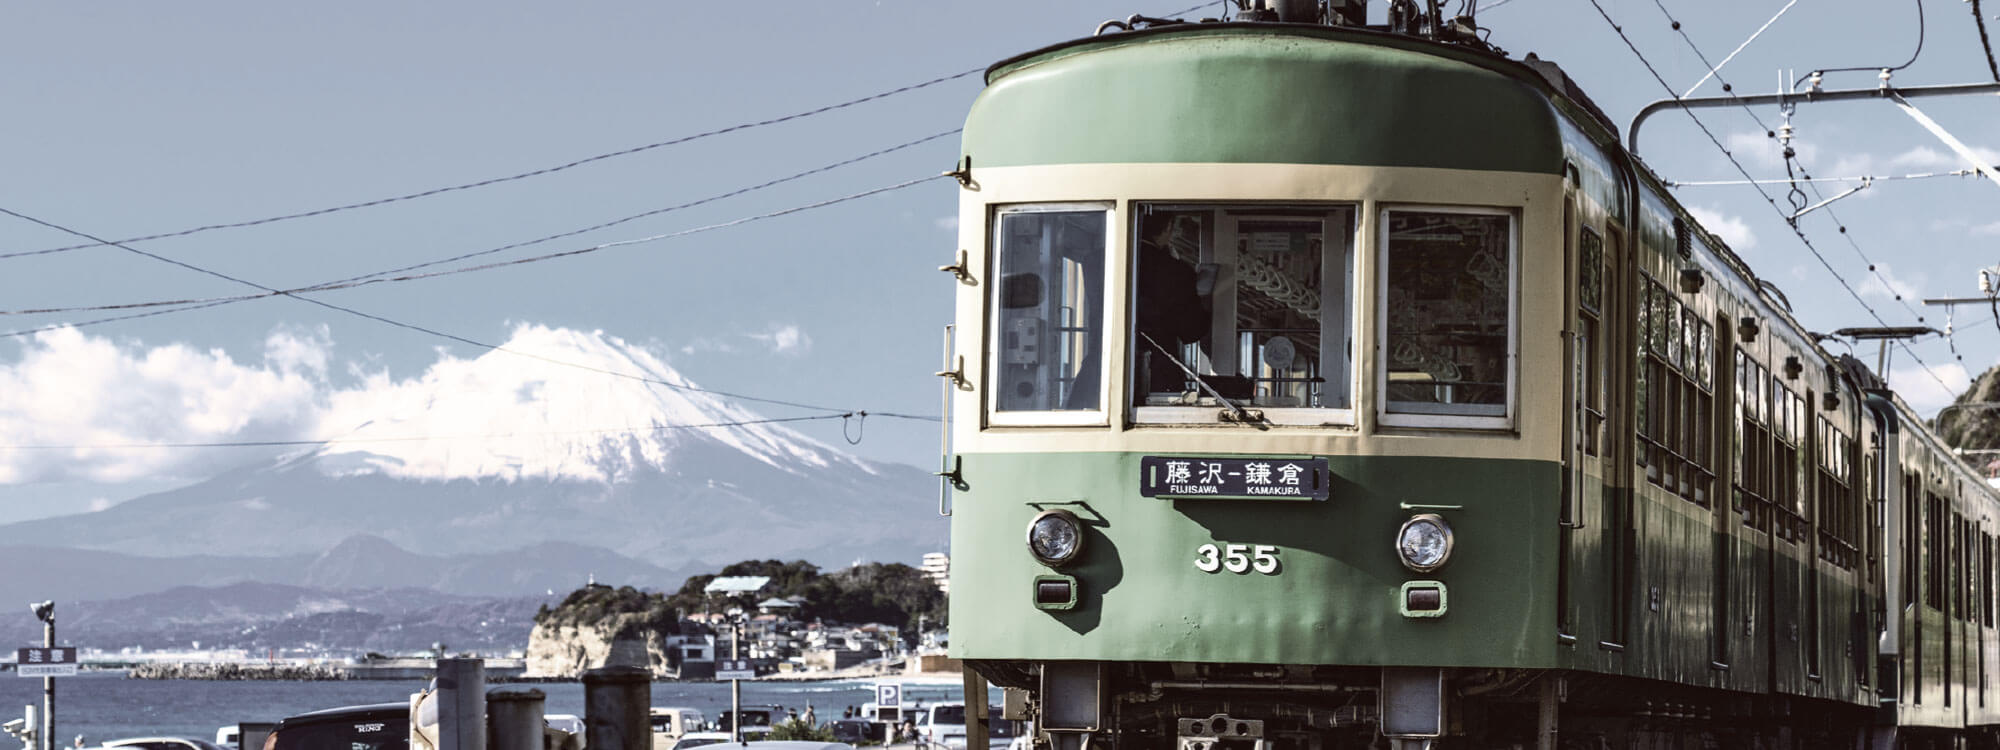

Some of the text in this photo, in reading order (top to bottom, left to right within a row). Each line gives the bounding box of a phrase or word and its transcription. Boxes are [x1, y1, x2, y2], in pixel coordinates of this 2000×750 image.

[1170, 485, 1301, 495] FUJISAWA KAMAKURA
[1195, 544, 1278, 574] 355
[880, 686, 896, 705] P
